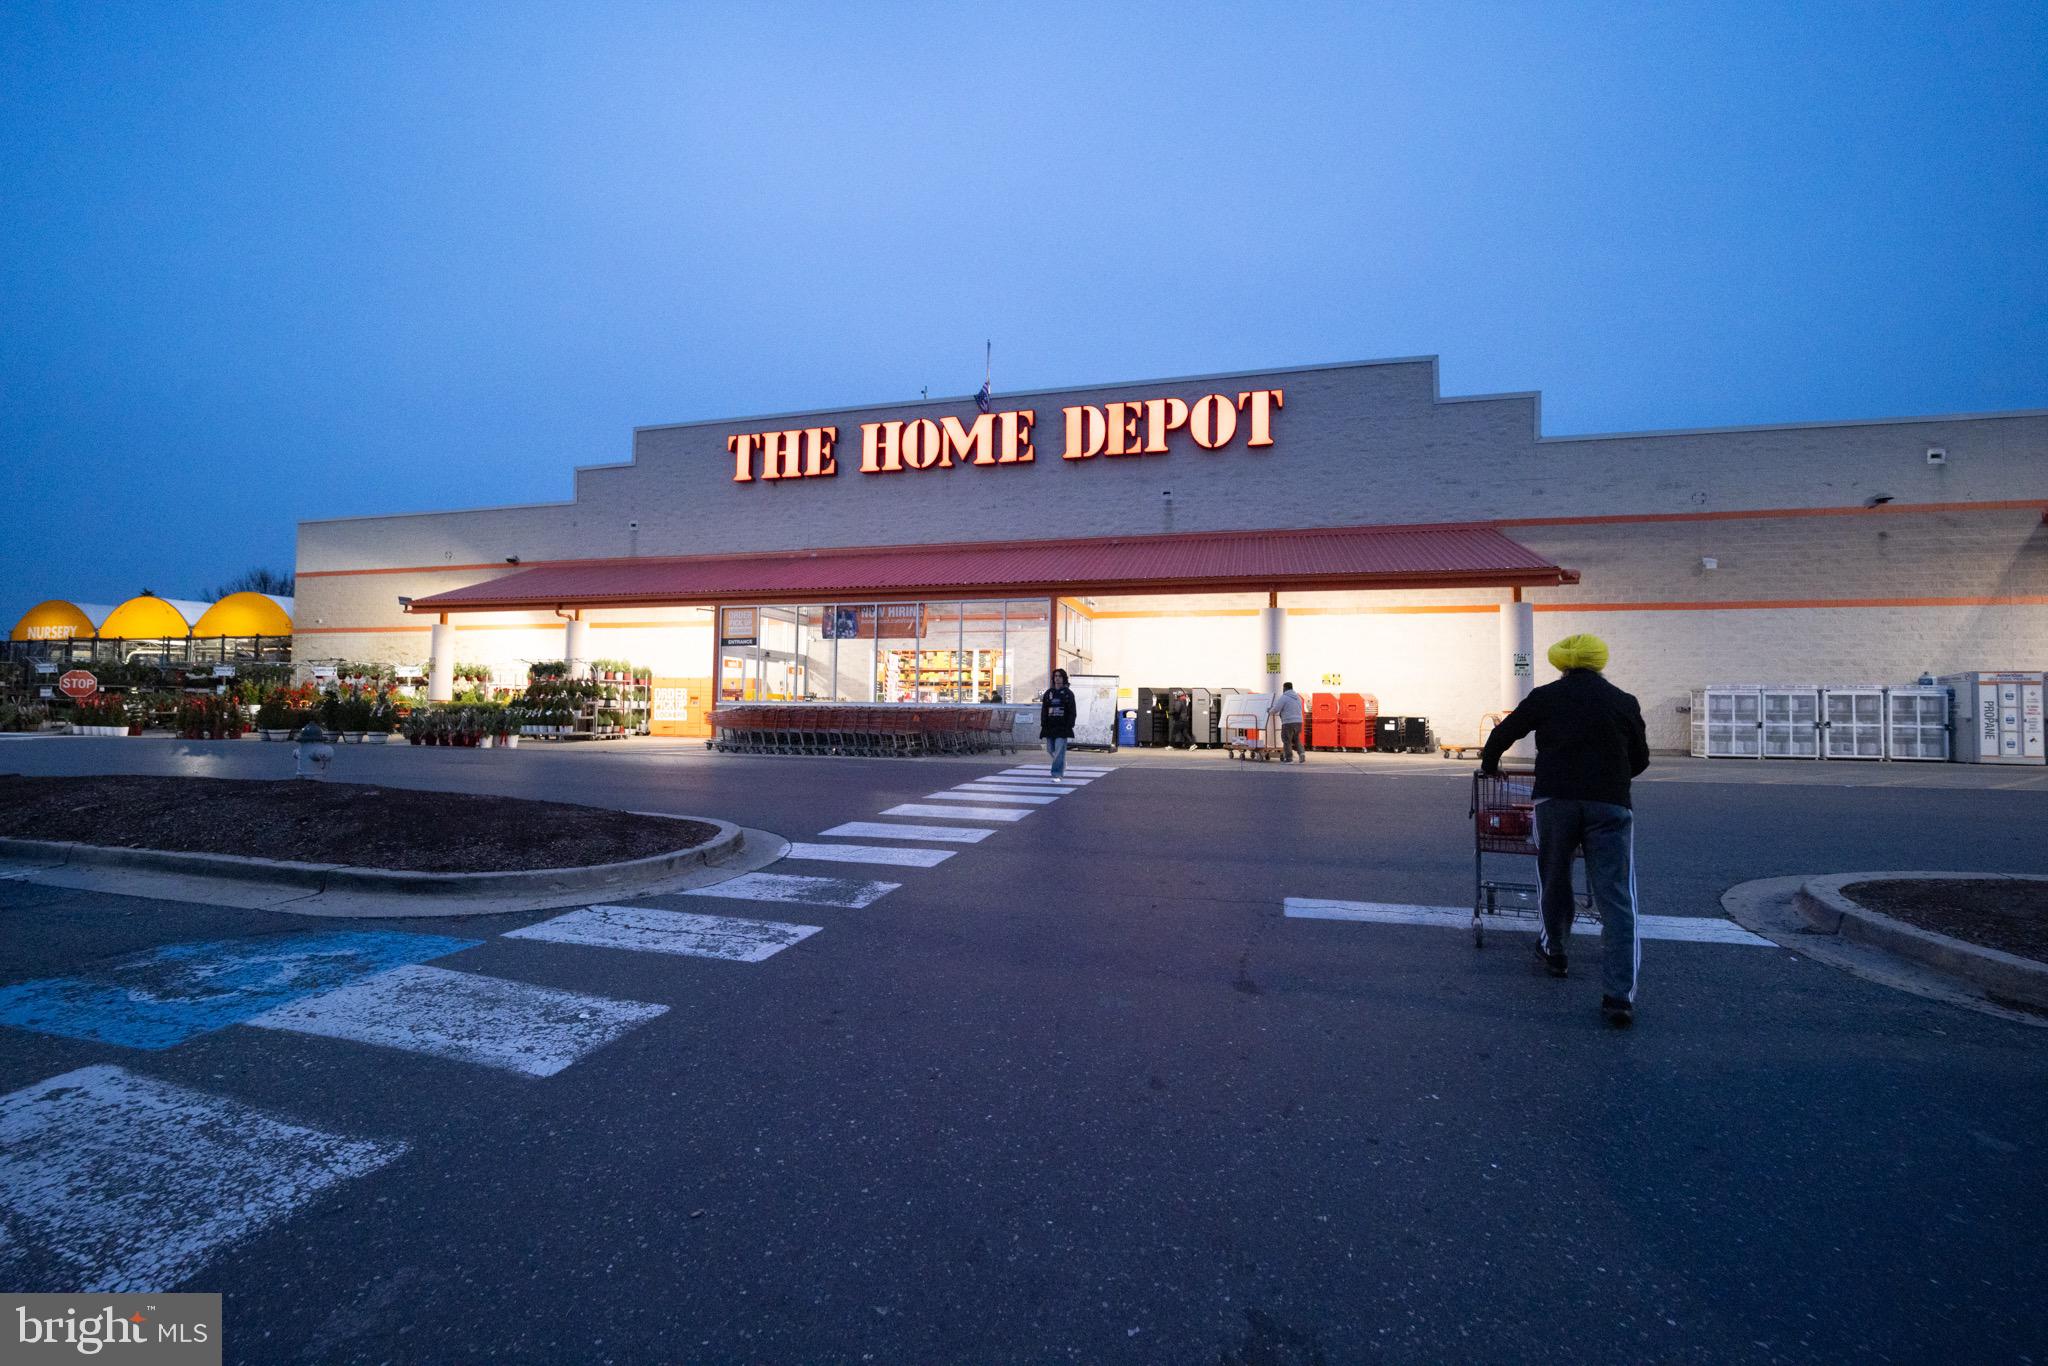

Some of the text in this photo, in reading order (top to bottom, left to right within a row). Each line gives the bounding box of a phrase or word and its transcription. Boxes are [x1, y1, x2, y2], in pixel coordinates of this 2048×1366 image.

[728, 389, 1284, 483] THE HOME DEPOT
[28, 626, 77, 639] NURSERY
[63, 678, 94, 689] STOP
[654, 688, 687, 700] ORDER
[1984, 700, 1996, 740] PROPANE
